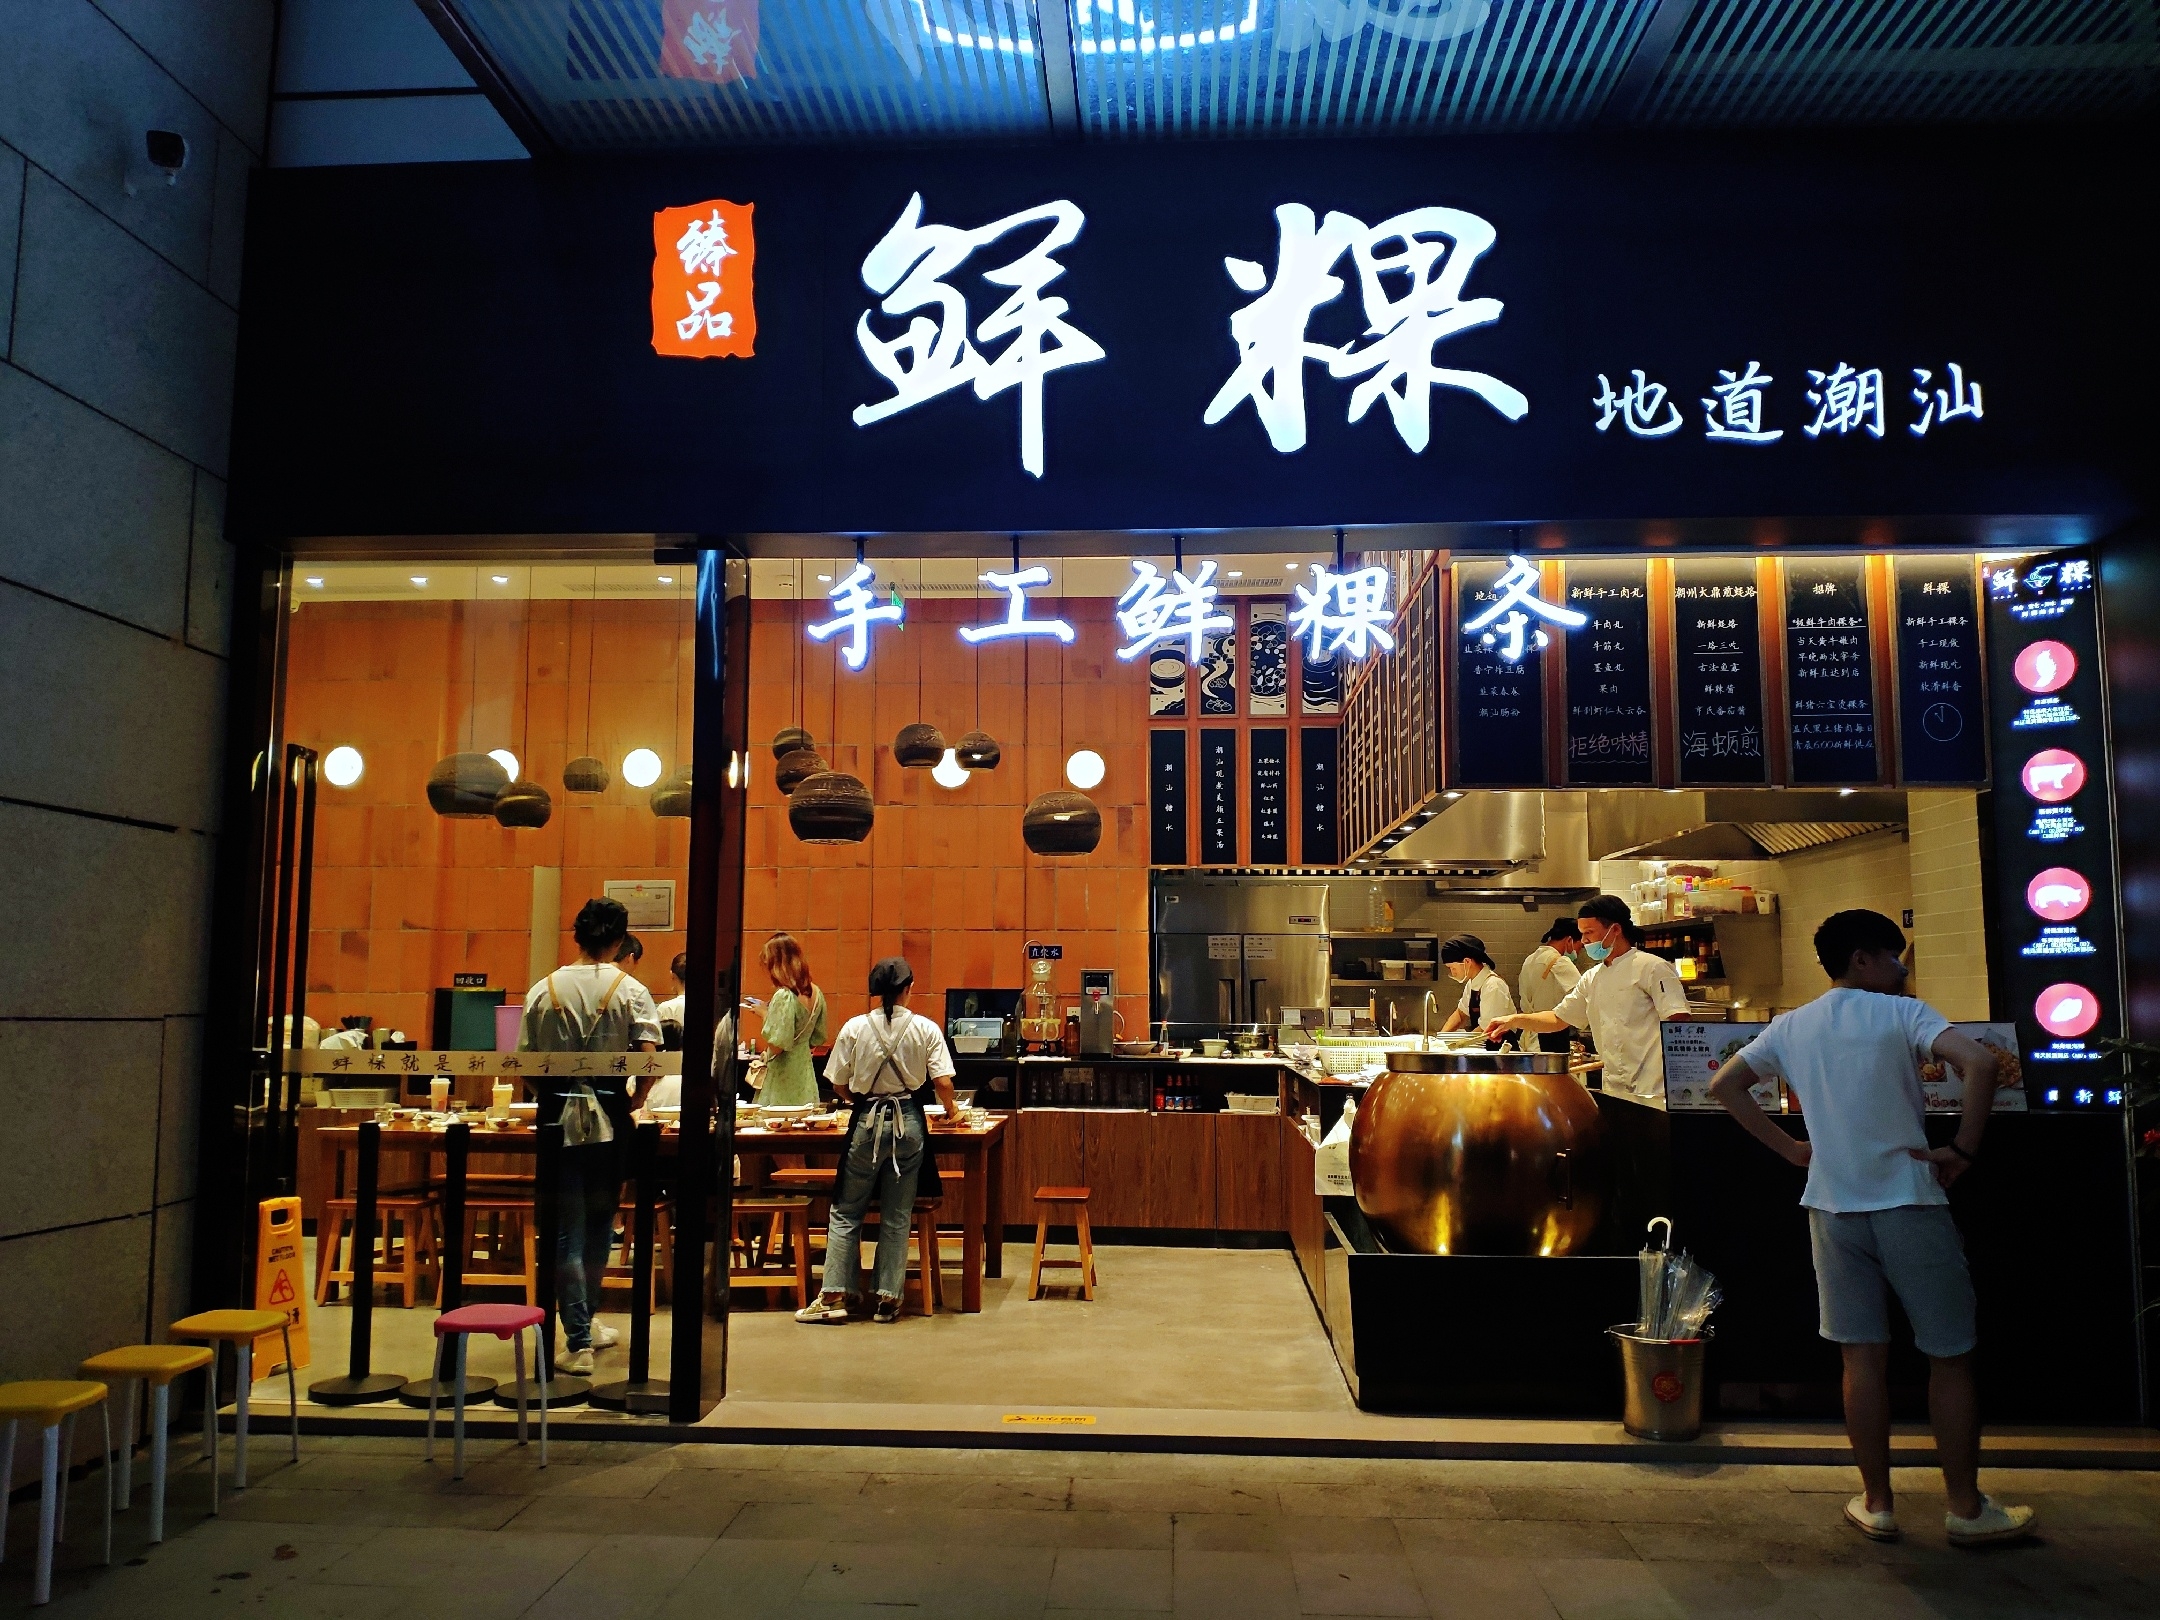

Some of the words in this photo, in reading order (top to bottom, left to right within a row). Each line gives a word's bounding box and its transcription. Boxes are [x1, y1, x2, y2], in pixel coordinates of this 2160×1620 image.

[676, 208, 738, 340] 臻品
[853, 191, 1528, 478] 鲜粿
[1593, 361, 1985, 441] 地道潮汕
[1571, 586, 1645, 599] 新鲜手工肉丸
[1674, 585, 1758, 599] 潮州大鼎煎蚝烙
[1812, 582, 1838, 597] 招牌
[1923, 582, 1952, 595] 鲜粿
[807, 555, 1587, 671] 手工鲜粿条
[1592, 619, 1624, 630] 牛肉丸
[1696, 618, 1739, 630] 新鲜蚝烙
[1906, 616, 1969, 627] 新鲜手工粿条
[1593, 641, 1625, 652] 牛筋丸
[1697, 640, 1740, 651] 一烙三吃
[1918, 638, 1961, 649] 手工现做
[1593, 662, 1625, 673] 墨鱼丸
[1918, 660, 1962, 670] 新鲜现吃
[1569, 729, 1649, 759] 拒绝味精
[1165, 764, 1173, 831] 潮汕糖水
[332, 1054, 663, 1074] 鲜粿就是新鲜手工粿条
